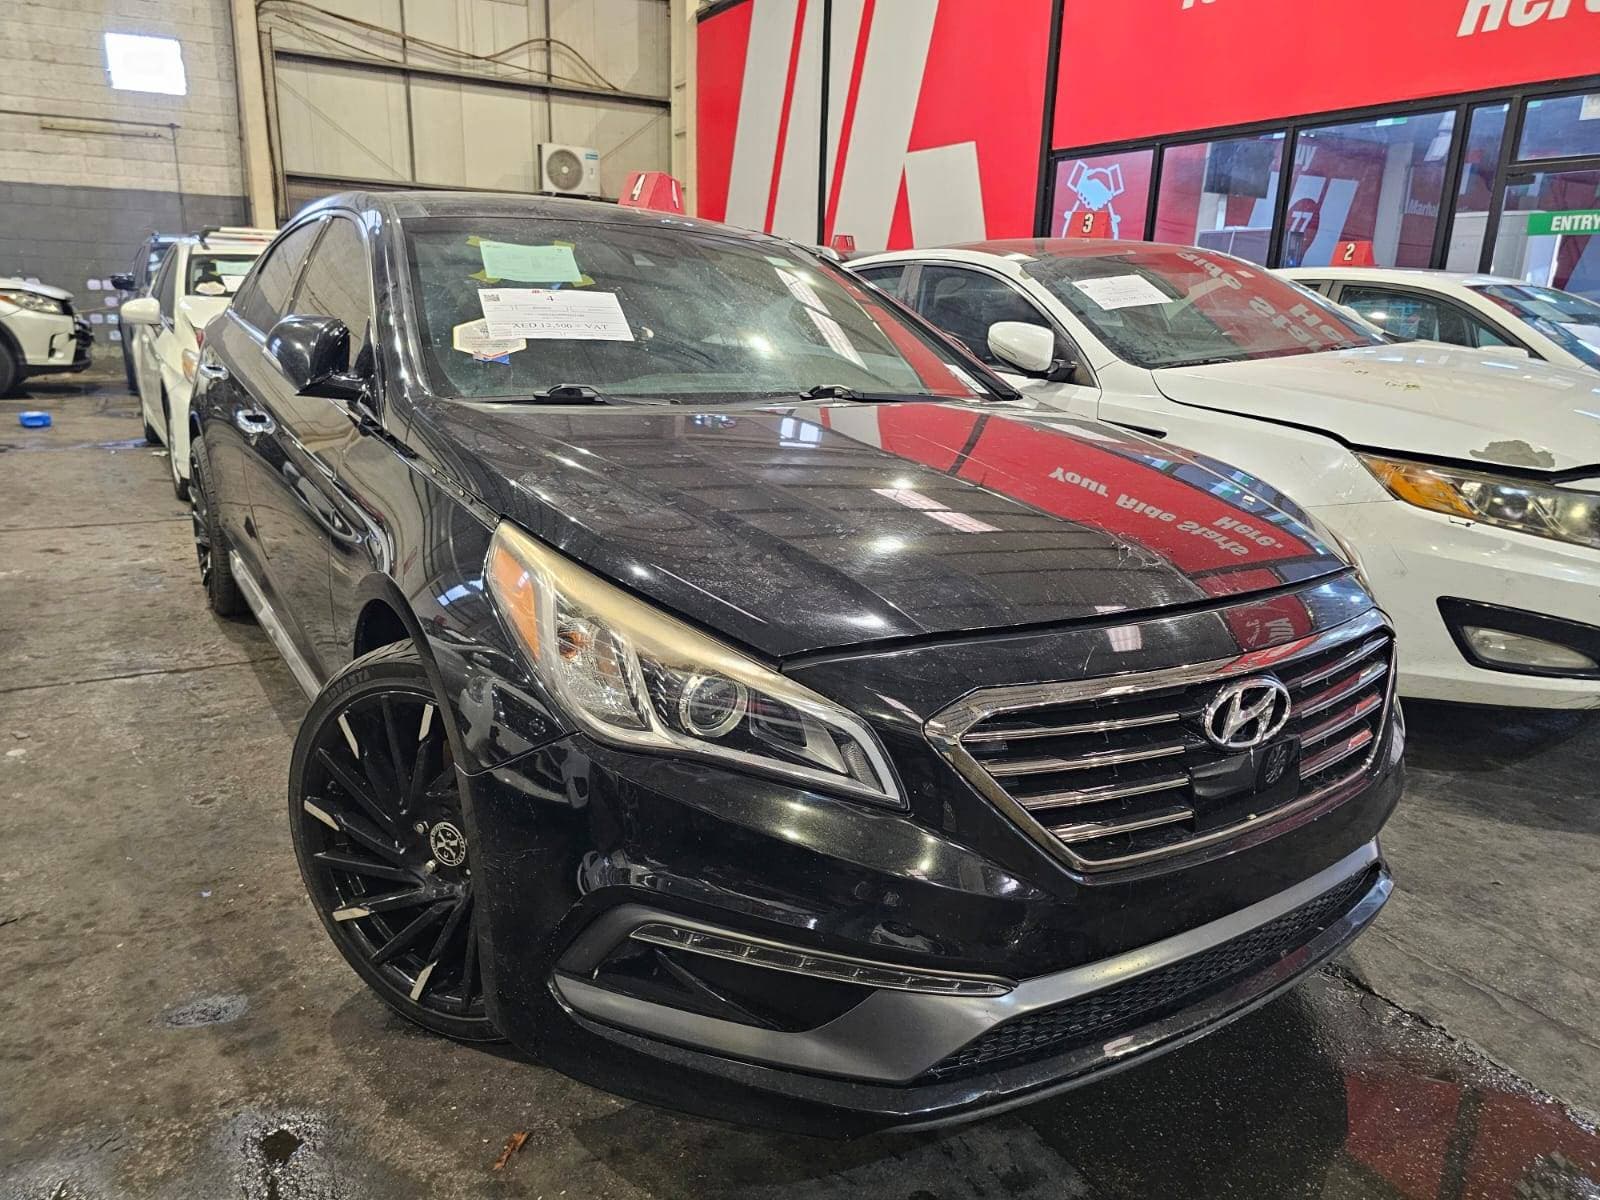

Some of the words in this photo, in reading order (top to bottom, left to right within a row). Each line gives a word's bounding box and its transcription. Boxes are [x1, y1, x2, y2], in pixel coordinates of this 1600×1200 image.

[632, 173, 646, 201] 4
[1082, 213, 1094, 233] 3
[1344, 243, 1356, 261] 2
[512, 321, 538, 329] AED
[584, 321, 608, 330] VAT
